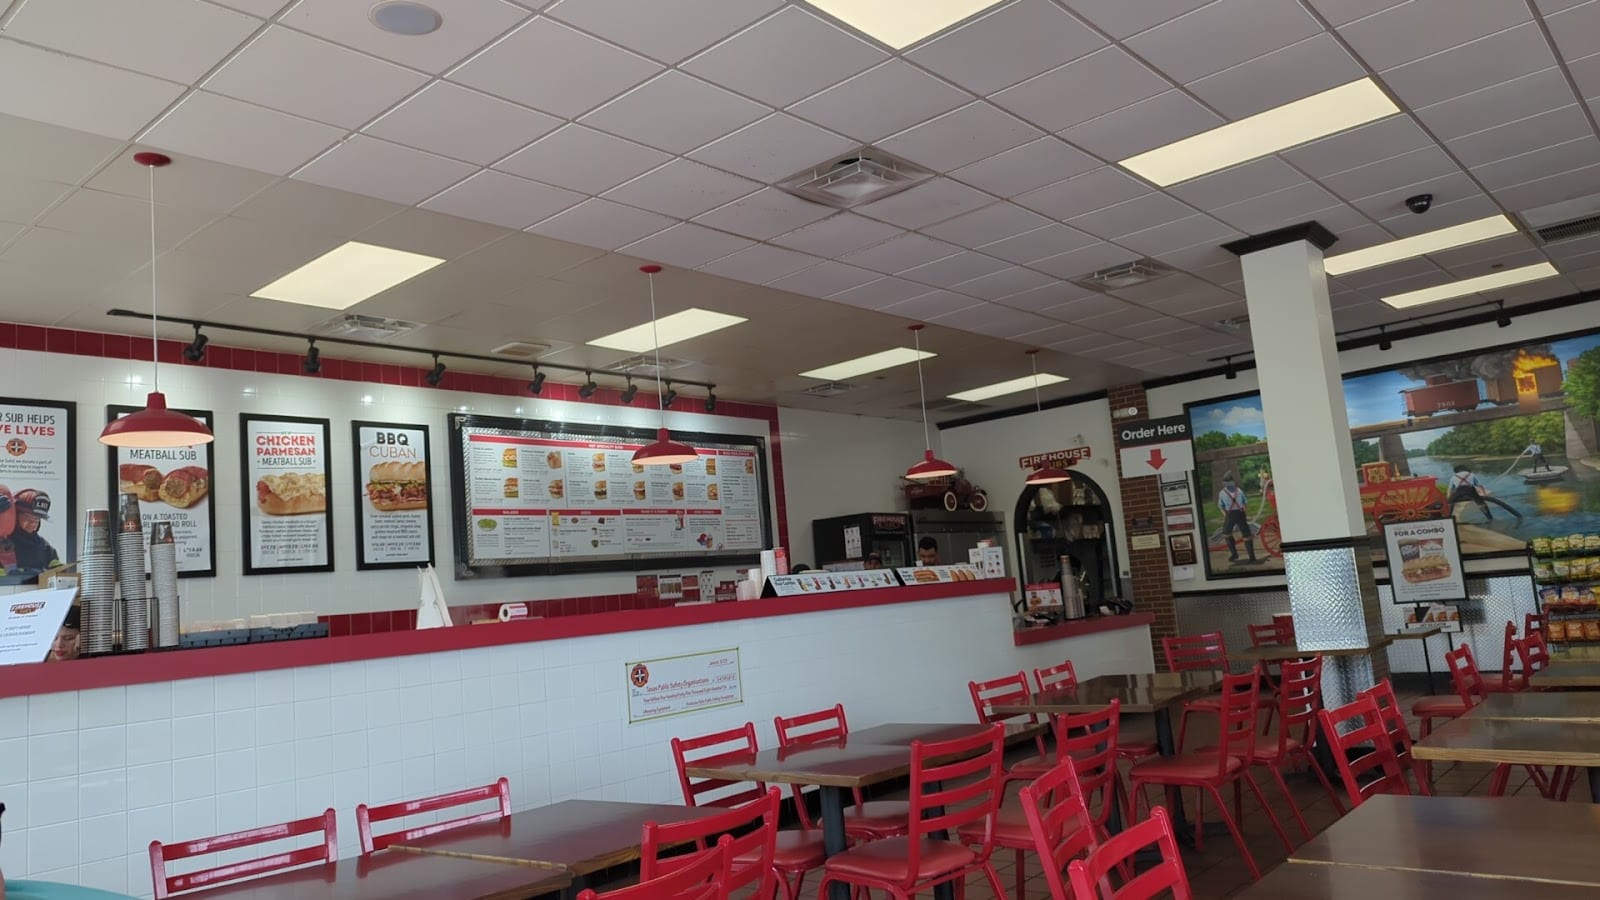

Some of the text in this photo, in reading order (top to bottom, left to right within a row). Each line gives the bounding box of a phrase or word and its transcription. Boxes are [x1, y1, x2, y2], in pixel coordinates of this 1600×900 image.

[5, 412, 24, 424] SUB
[27, 414, 56, 425] HELPS
[16, 425, 56, 437] LIVES
[1121, 424, 1186, 441] Order Here
[256, 435, 315, 446] CHICKEN
[376, 432, 409, 446] BBQ
[130, 449, 197, 461] MEATBALL SUB
[256, 447, 316, 456] PARMESAN
[370, 446, 416, 458] CUBAN
[262, 457, 313, 466] MEATBALL SUB
[1021, 448, 1089, 470] FIREHOUSE
[160, 513, 188, 521] TOASTED
[181, 520, 197, 528] ROLL
[1416, 527, 1445, 535] COMBO
